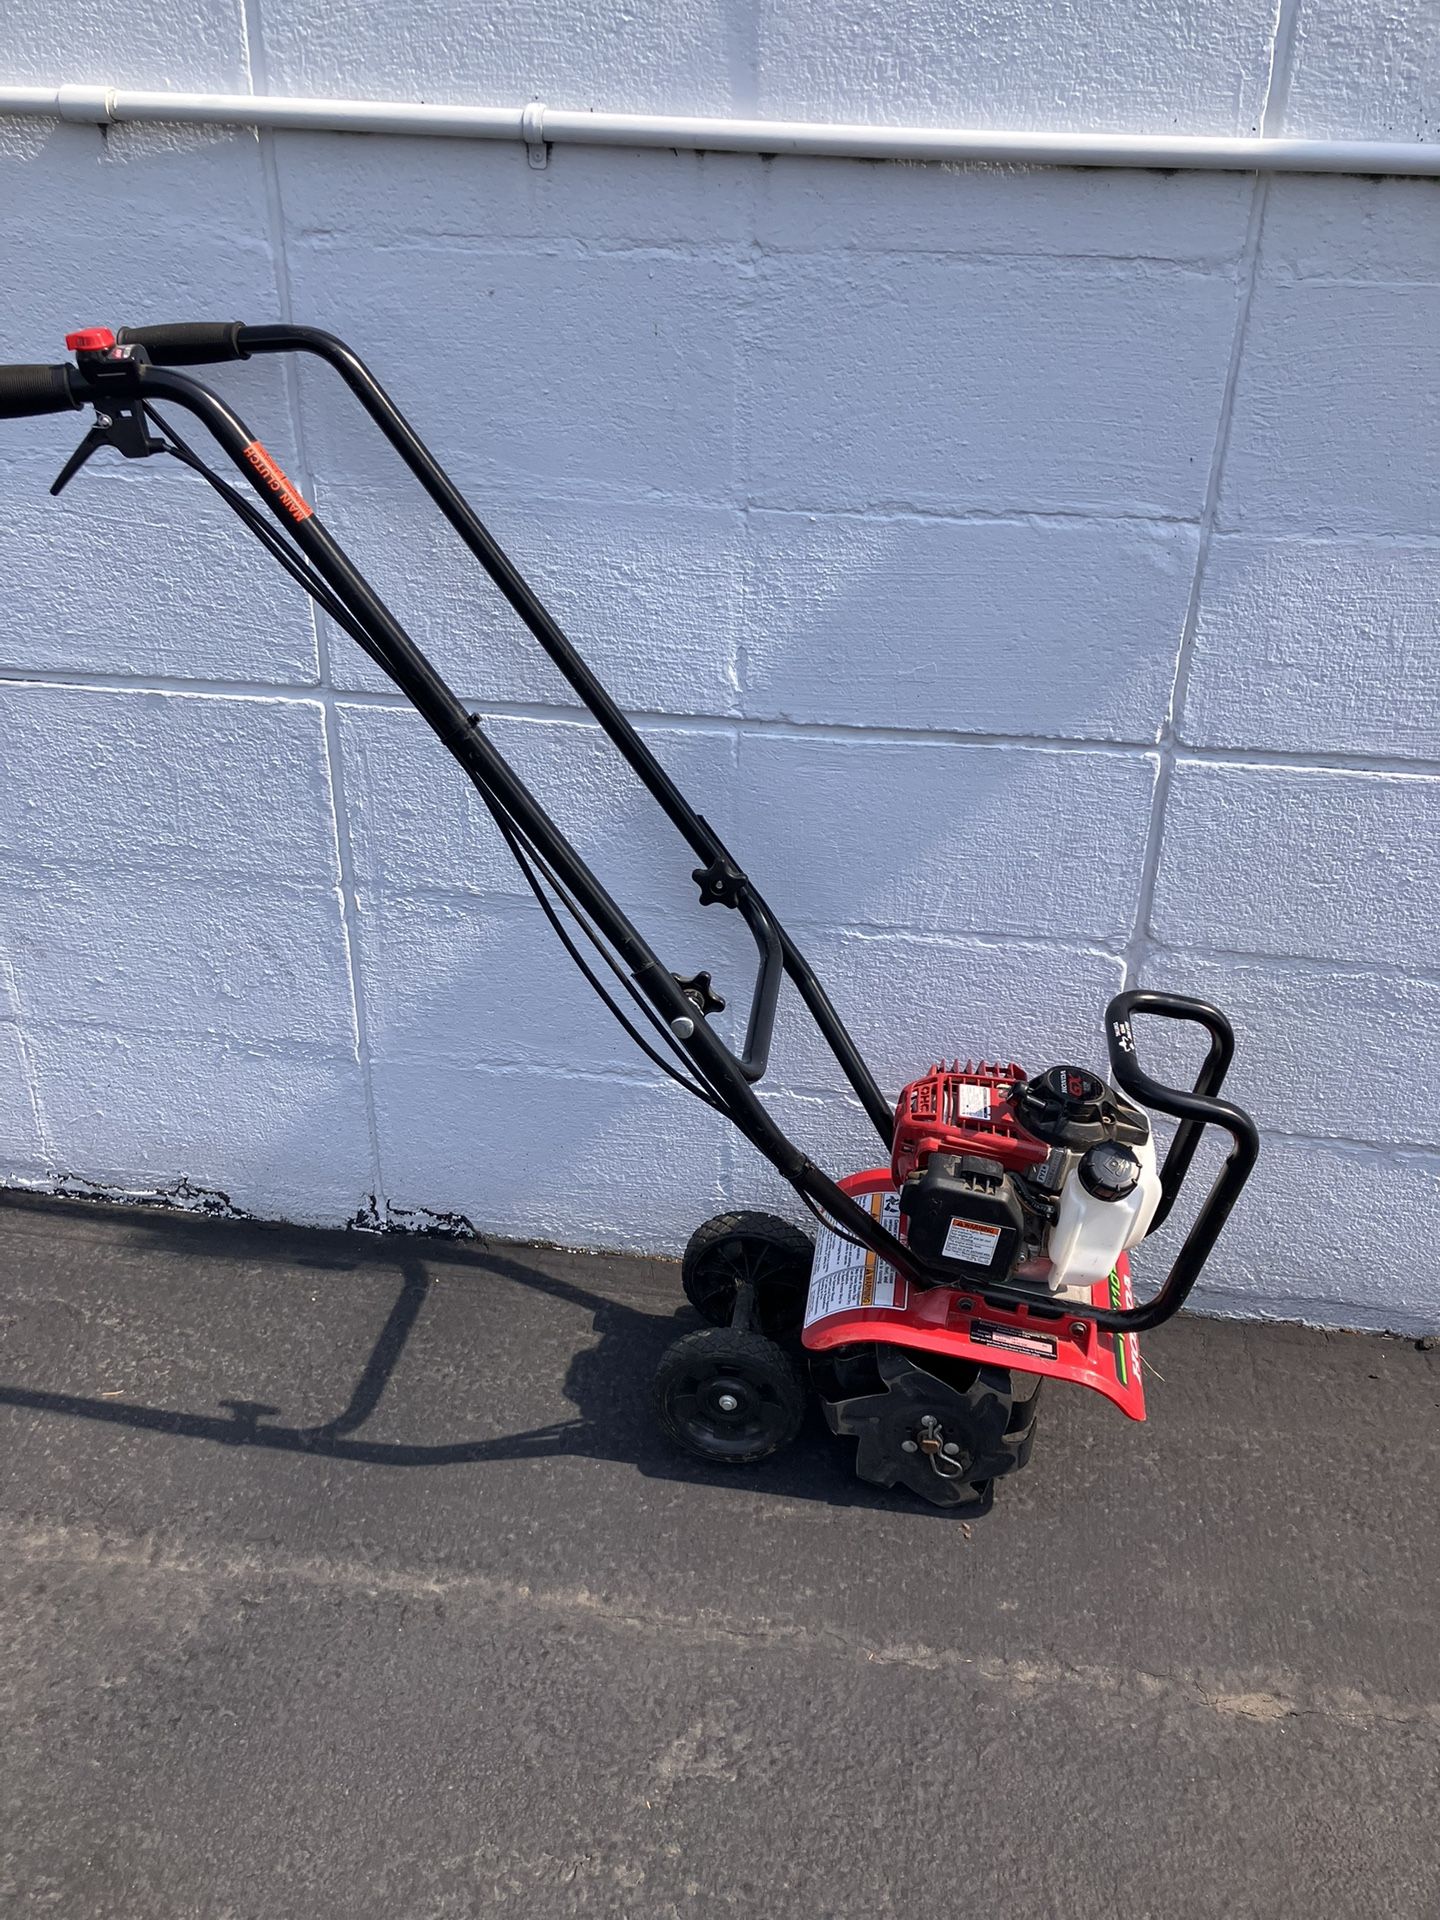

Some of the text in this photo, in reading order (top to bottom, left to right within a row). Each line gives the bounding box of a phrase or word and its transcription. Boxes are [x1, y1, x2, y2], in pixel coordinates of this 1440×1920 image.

[243, 447, 281, 491] CLUTCH
[280, 493, 305, 522] MAIN
[1067, 1073, 1083, 1097] GX
[920, 1086, 930, 1112] OHC
